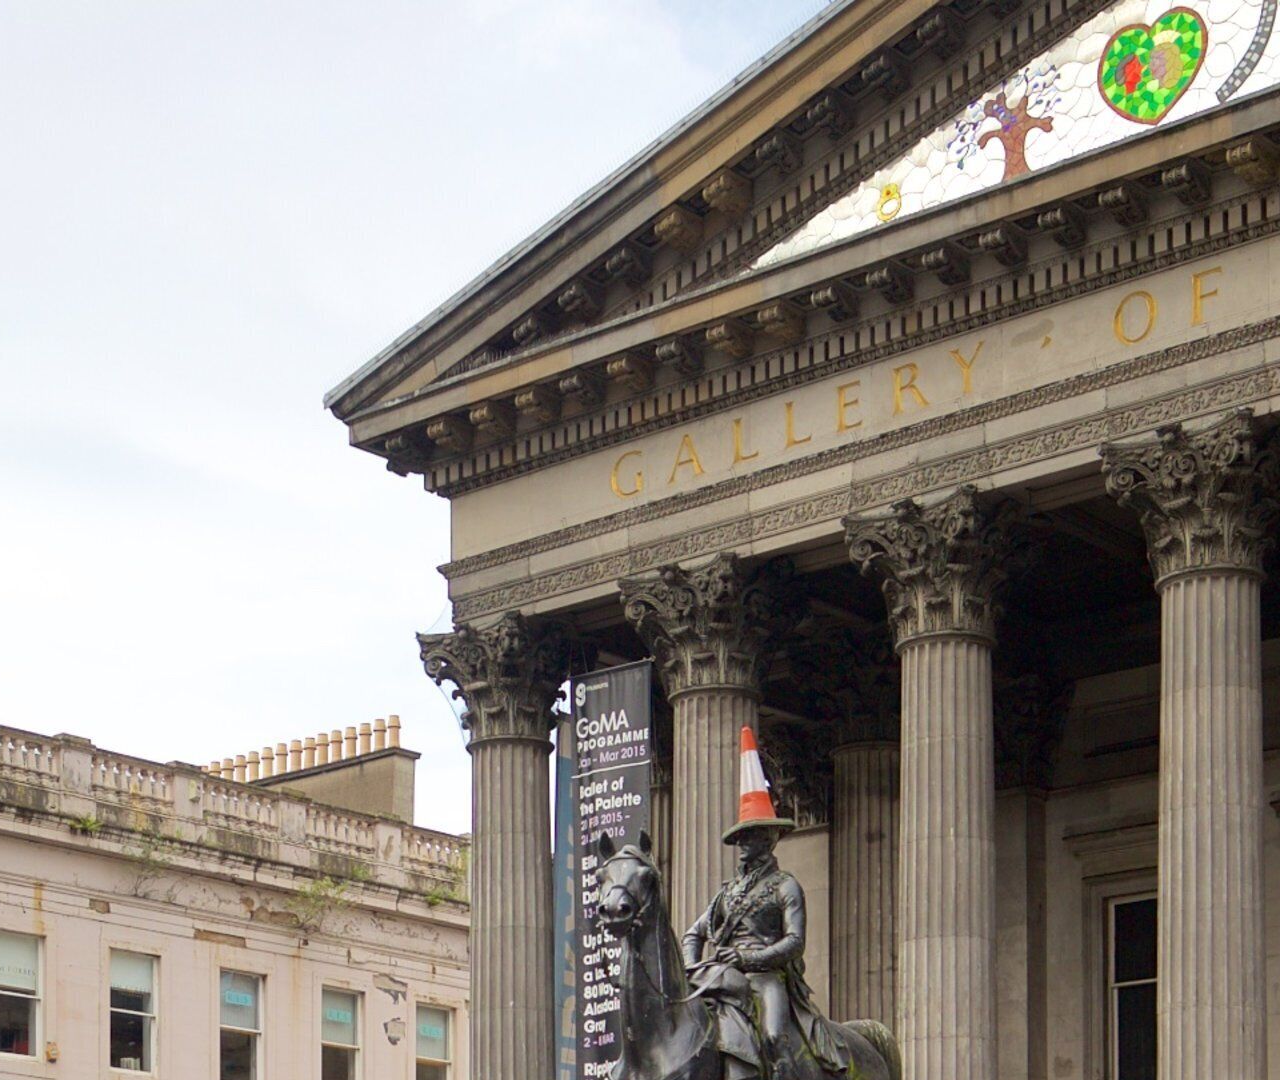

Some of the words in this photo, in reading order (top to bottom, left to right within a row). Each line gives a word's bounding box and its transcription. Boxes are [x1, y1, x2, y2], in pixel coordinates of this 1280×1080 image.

[609, 338, 987, 501] GALLERY
[1111, 265, 1224, 347] OF
[576, 708, 630, 739] GoMA
[577, 727, 649, 753] PROGRAMME
[600, 750, 619, 763] Mar
[620, 744, 646, 760] 2015
[611, 776, 625, 792] of
[595, 791, 642, 812] Palette
[600, 811, 624, 825] 2015
